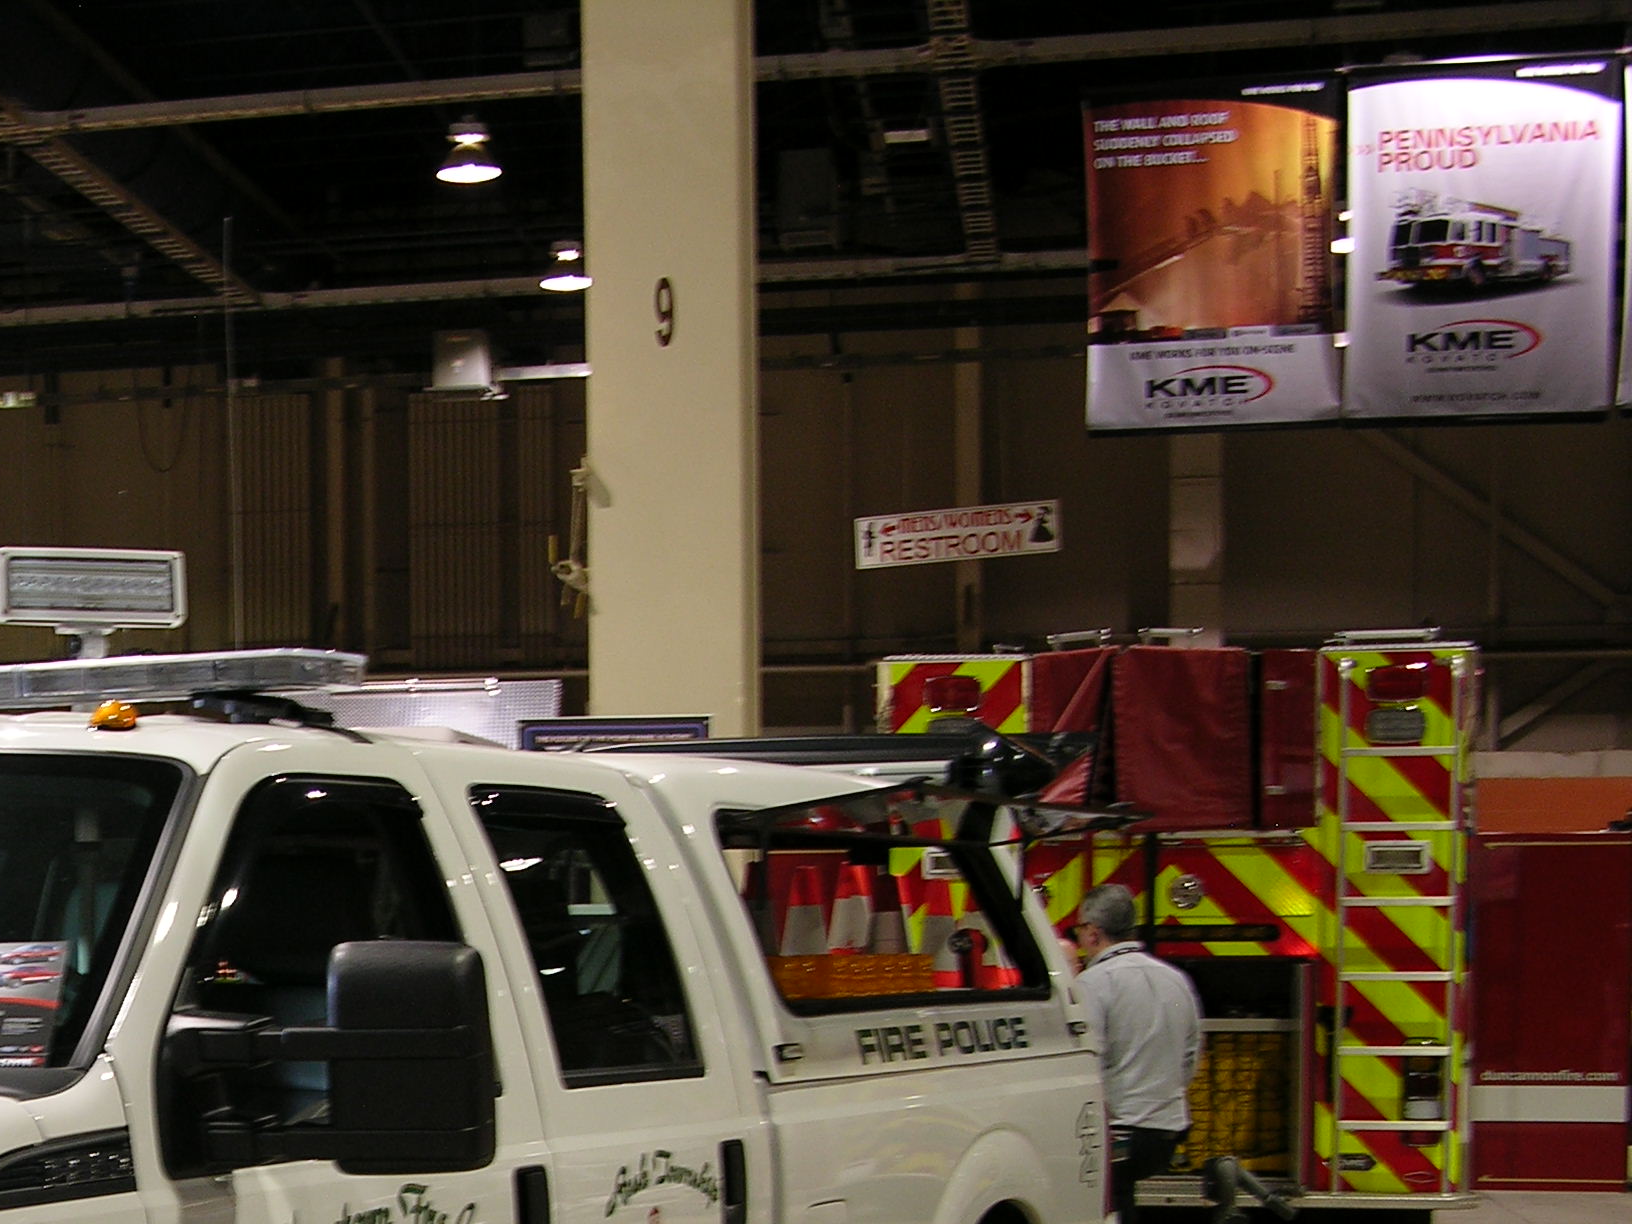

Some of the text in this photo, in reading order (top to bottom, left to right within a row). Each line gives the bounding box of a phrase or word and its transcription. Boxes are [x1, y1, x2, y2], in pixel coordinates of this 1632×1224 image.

[1093, 111, 1231, 132] THE WALL AND ROOF
[1093, 134, 1161, 151] SUDDENLY
[1377, 119, 1601, 150] PENNSYLVANIA
[1093, 155, 1116, 169] ON
[1117, 153, 1143, 167] THE
[1377, 149, 1477, 173] PROUD
[654, 277, 673, 347] 9
[1406, 330, 1520, 352] KME
[1144, 375, 1254, 398] KME
[880, 530, 1024, 562] RESTROOM
[854, 1017, 1030, 1066] FIRE POLICE
